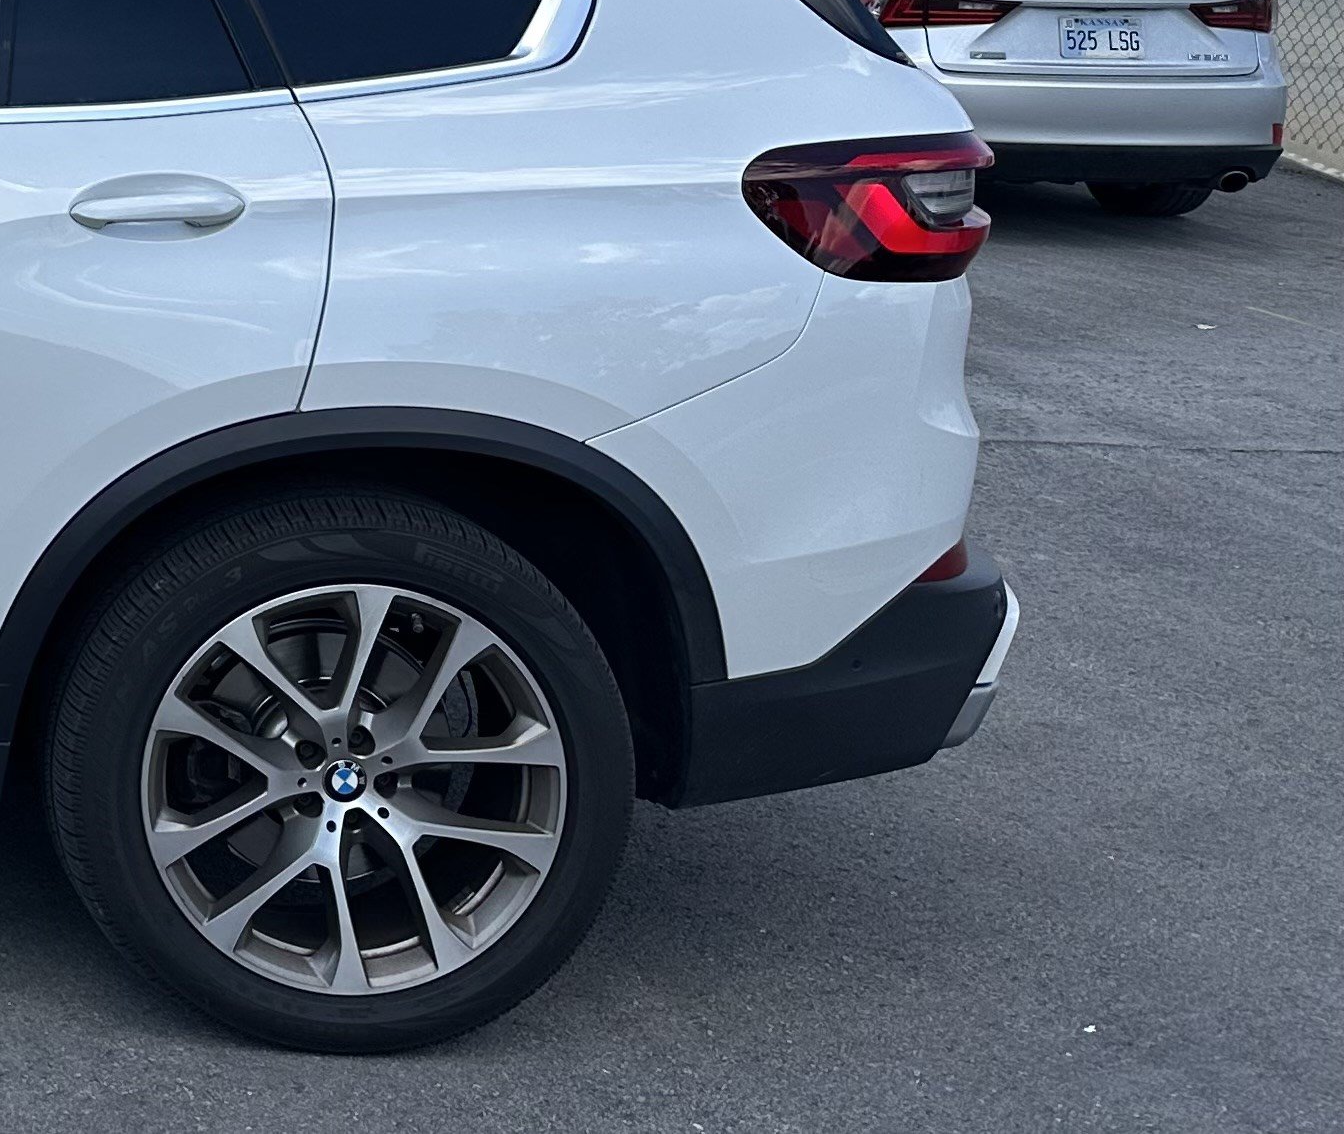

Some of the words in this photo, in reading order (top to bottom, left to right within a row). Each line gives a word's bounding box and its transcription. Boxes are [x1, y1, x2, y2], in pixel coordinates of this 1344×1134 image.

[1079, 17, 1126, 27] KANSAS
[1066, 29, 1098, 51] 525
[1108, 30, 1140, 51] LSG
